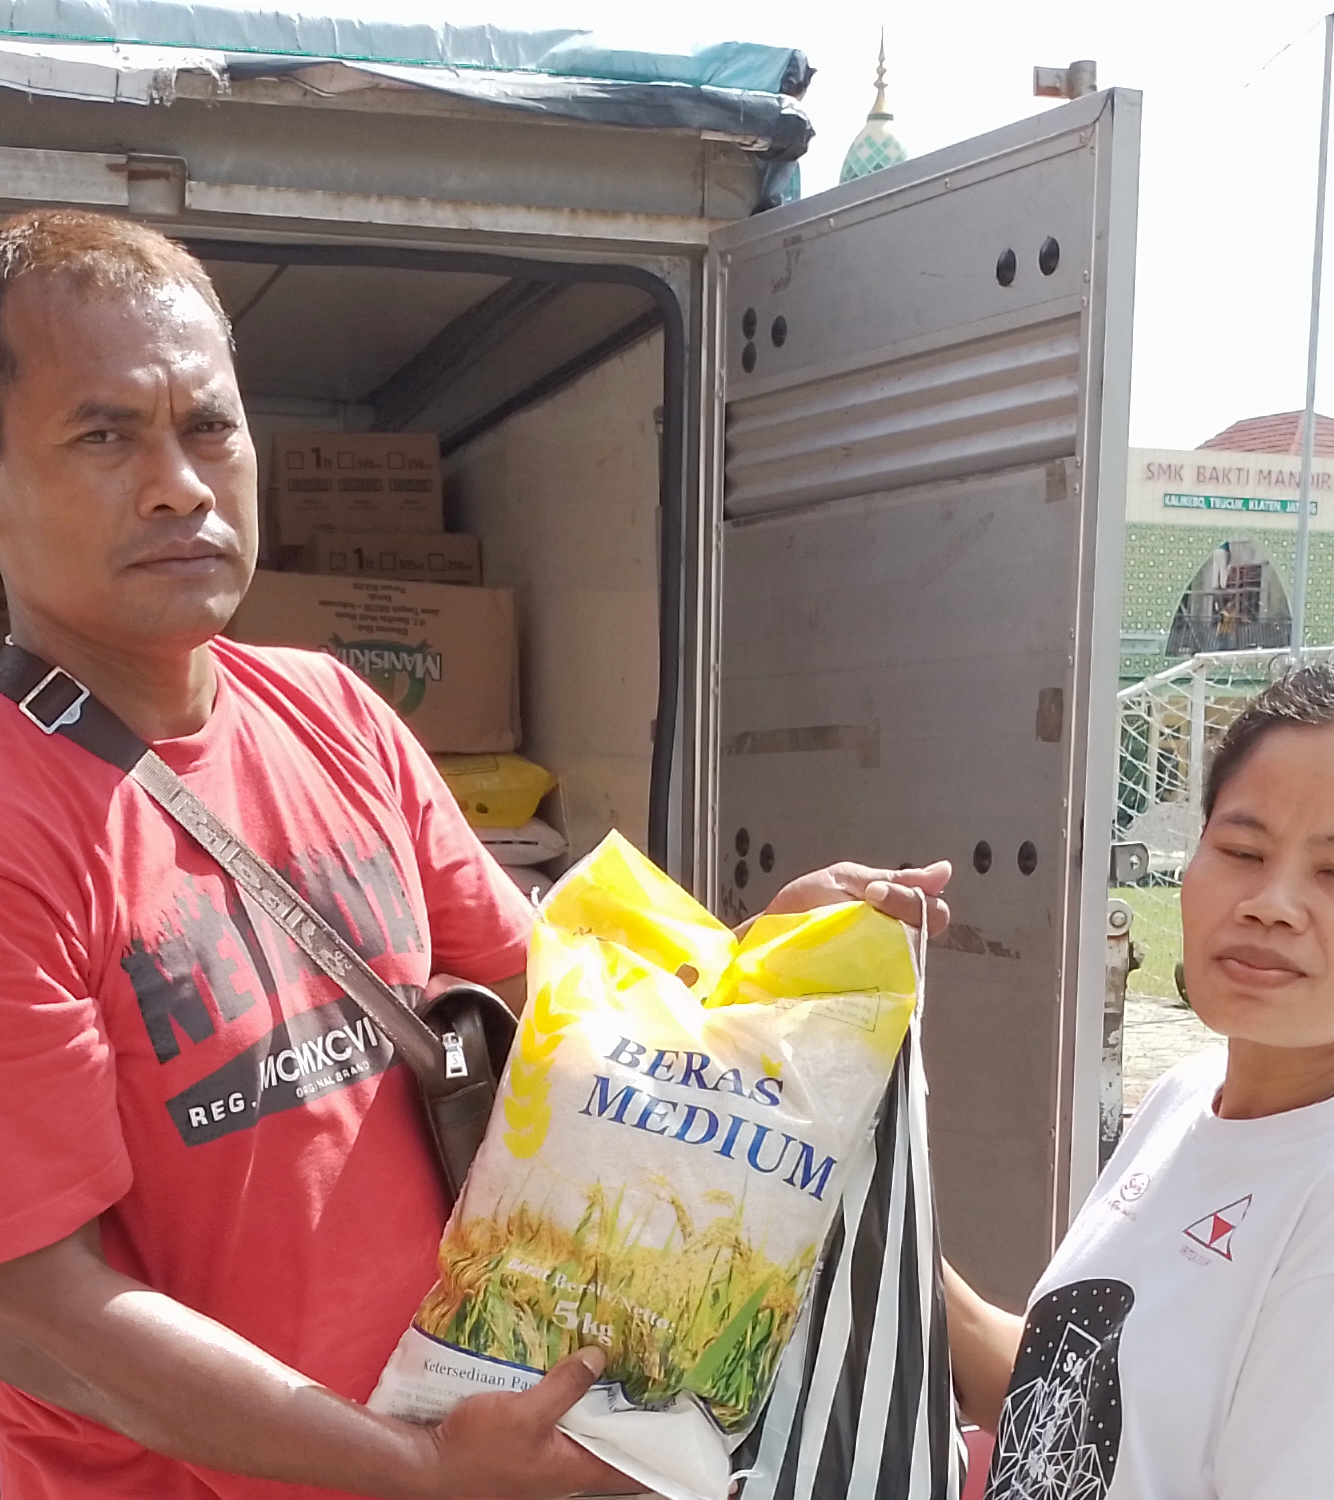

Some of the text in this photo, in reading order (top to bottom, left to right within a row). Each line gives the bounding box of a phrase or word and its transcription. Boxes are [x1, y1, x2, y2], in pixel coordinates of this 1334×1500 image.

[1146, 462, 1184, 482] SMK
[1196, 465, 1250, 487] BAKTI
[1286, 502, 1317, 515] JATG
[322, 646, 442, 682] MANISKIT
[258, 1017, 379, 1092] MCMXCVI
[604, 1035, 784, 1108] BERAS
[336, 1060, 371, 1088] BRAND
[188, 1093, 258, 1128] REG.
[578, 1075, 839, 1203] MEDIUM
[552, 1299, 614, 1347] 5 kg
[423, 1358, 506, 1387] Ketersediaan
